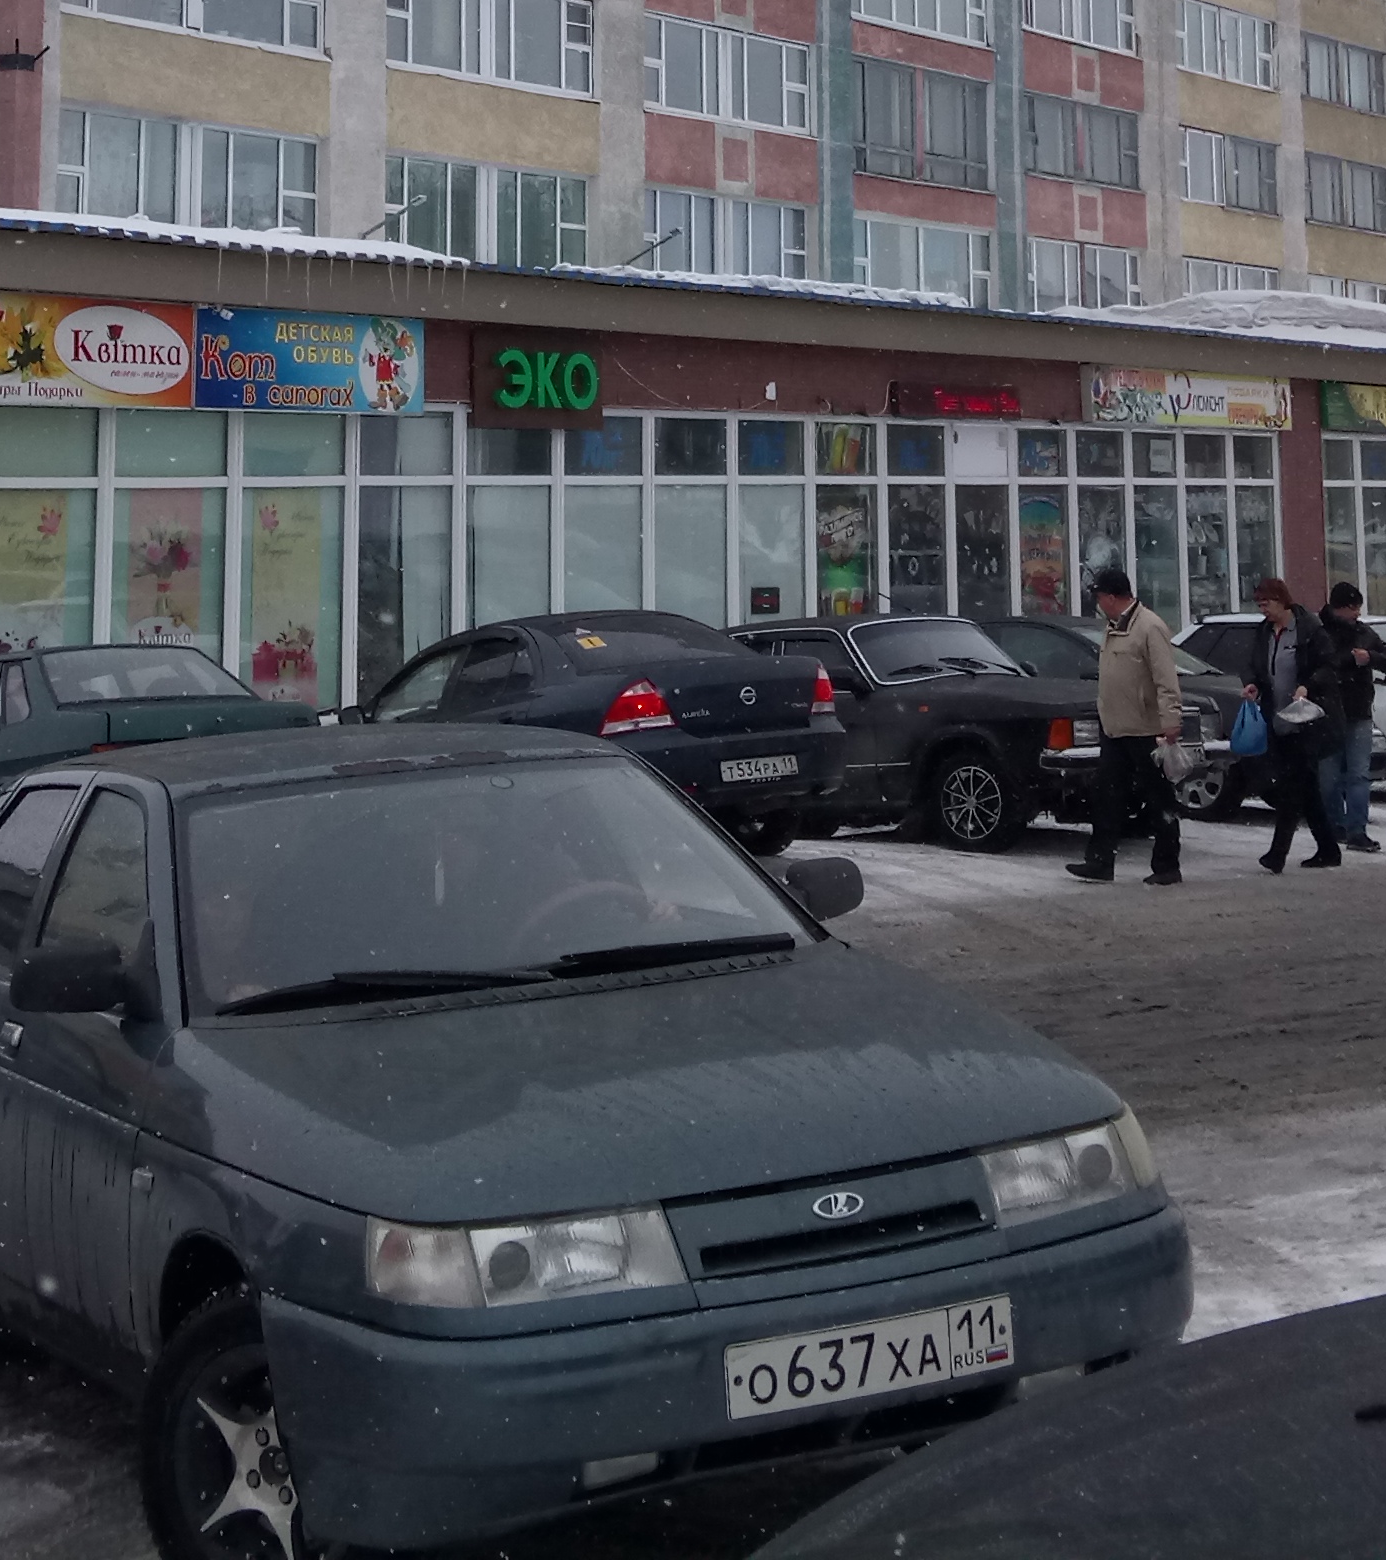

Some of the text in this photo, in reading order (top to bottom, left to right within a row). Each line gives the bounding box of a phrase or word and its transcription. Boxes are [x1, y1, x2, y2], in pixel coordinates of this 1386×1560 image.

[275, 321, 354, 344] ДЕТСКАЯ
[199, 333, 277, 381] Кот
[293, 345, 355, 365] ОБУВЬ
[27, 381, 83, 400] Подарки
[498, 349, 598, 410] ЭКО
[267, 379, 355, 408] сапогах
[957, 1304, 996, 1350] 11
[953, 1350, 985, 1370] RUS
